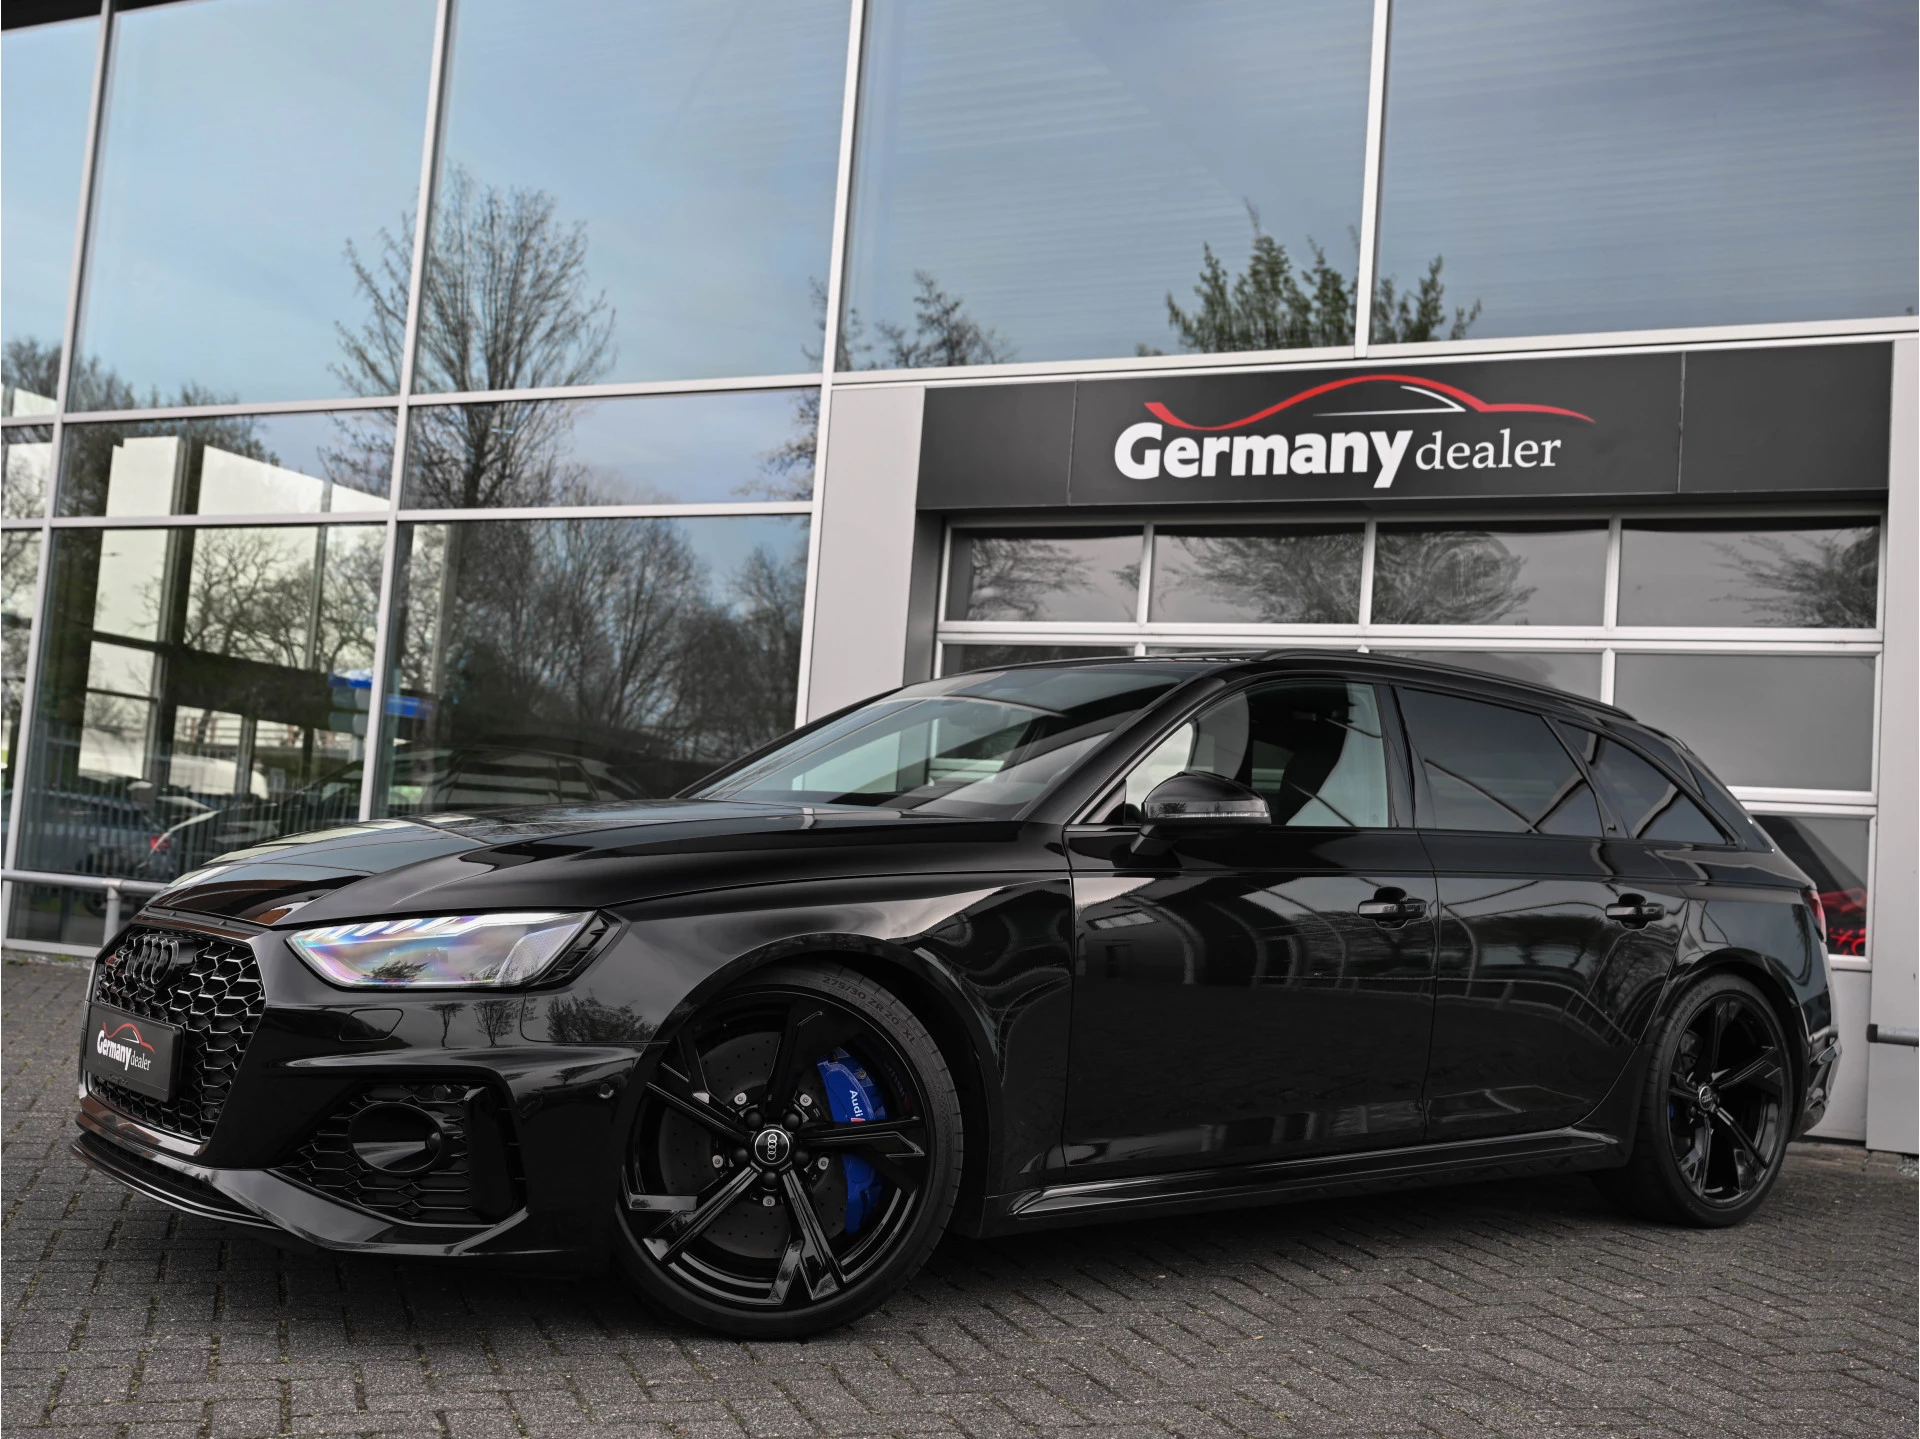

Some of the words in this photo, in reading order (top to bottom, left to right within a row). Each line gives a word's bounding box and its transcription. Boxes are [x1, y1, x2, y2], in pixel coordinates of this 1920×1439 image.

[1114, 422, 1413, 488] Germany
[1415, 428, 1562, 471] dealer
[822, 976, 867, 1000] 275/30
[902, 1029, 916, 1046] XL
[96, 1030, 133, 1071] Germany
[130, 1051, 152, 1071] dealer
[849, 1089, 864, 1118] Audi
